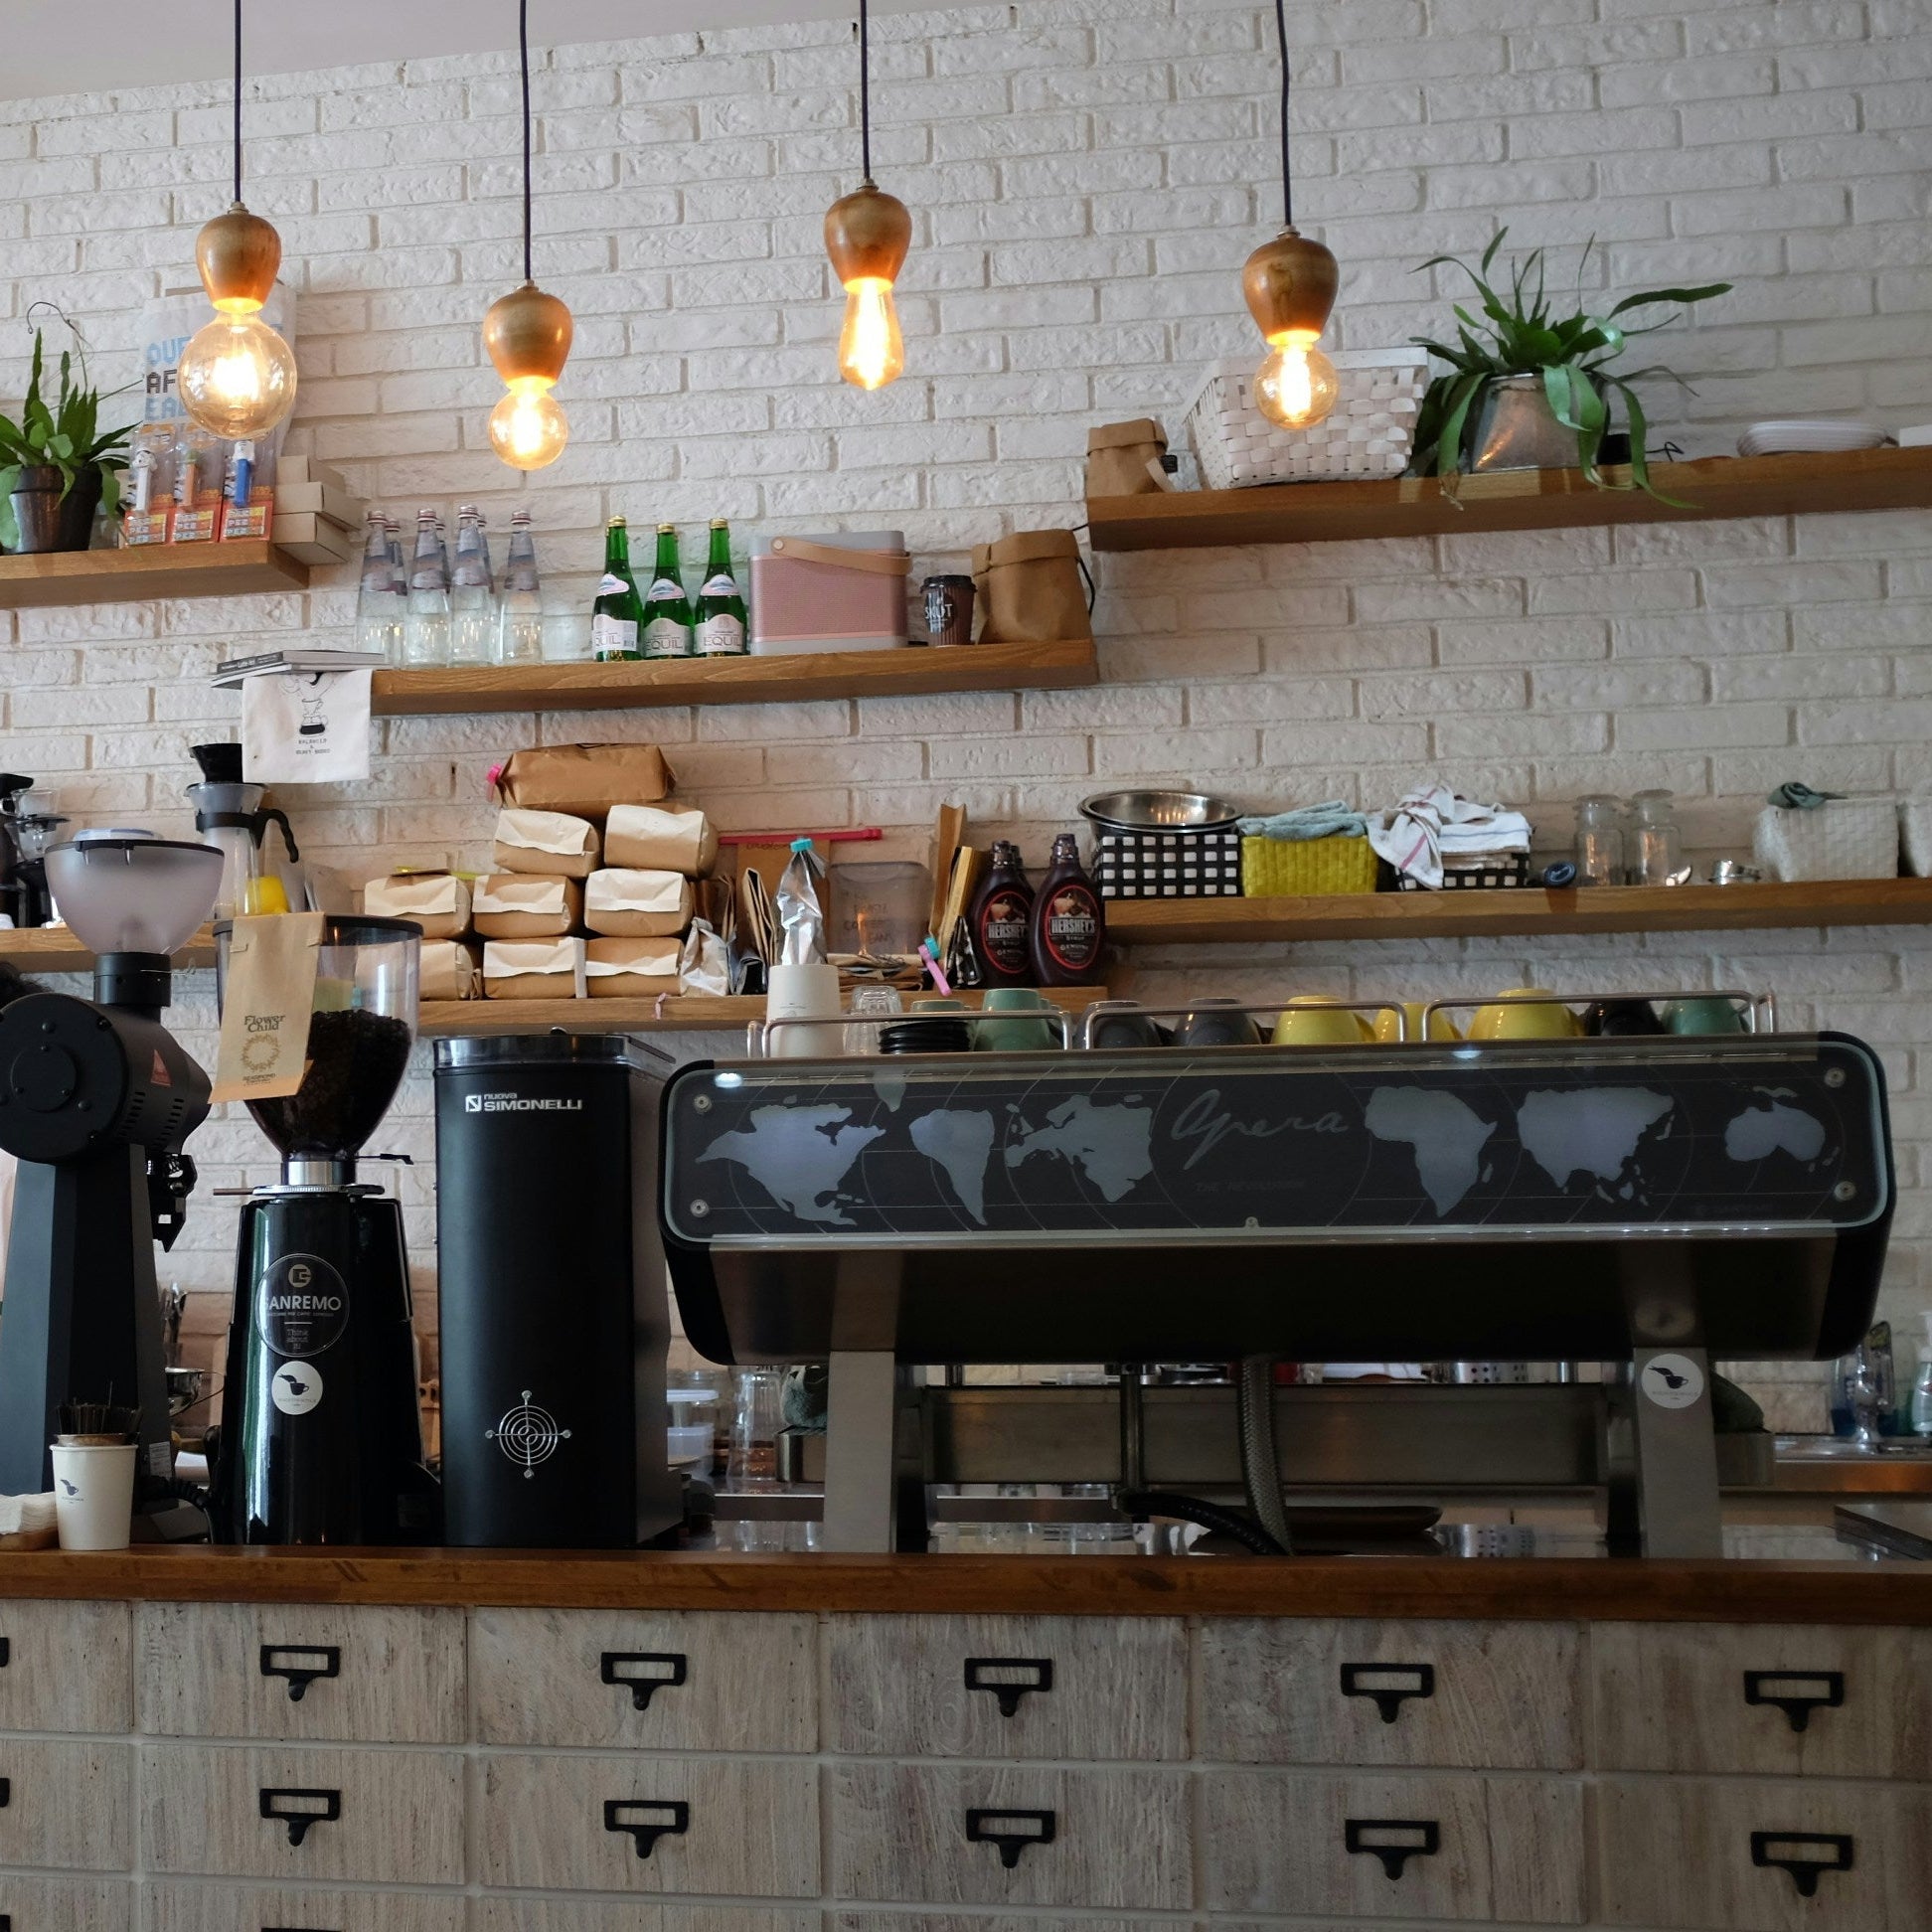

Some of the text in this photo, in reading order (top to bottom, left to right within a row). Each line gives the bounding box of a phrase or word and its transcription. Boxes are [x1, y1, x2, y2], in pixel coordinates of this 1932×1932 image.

[146, 369, 178, 394] AF
[595, 633, 621, 645] QUIL
[646, 636, 683, 651] EQUIL
[703, 635, 740, 646] EQUIL
[988, 923, 1028, 939] HERSHEY
[1051, 918, 1095, 934] HERSHEY'S
[243, 1015, 286, 1026] Flower
[247, 1020, 279, 1033] Child
[484, 1099, 583, 1112] SIMONELLI
